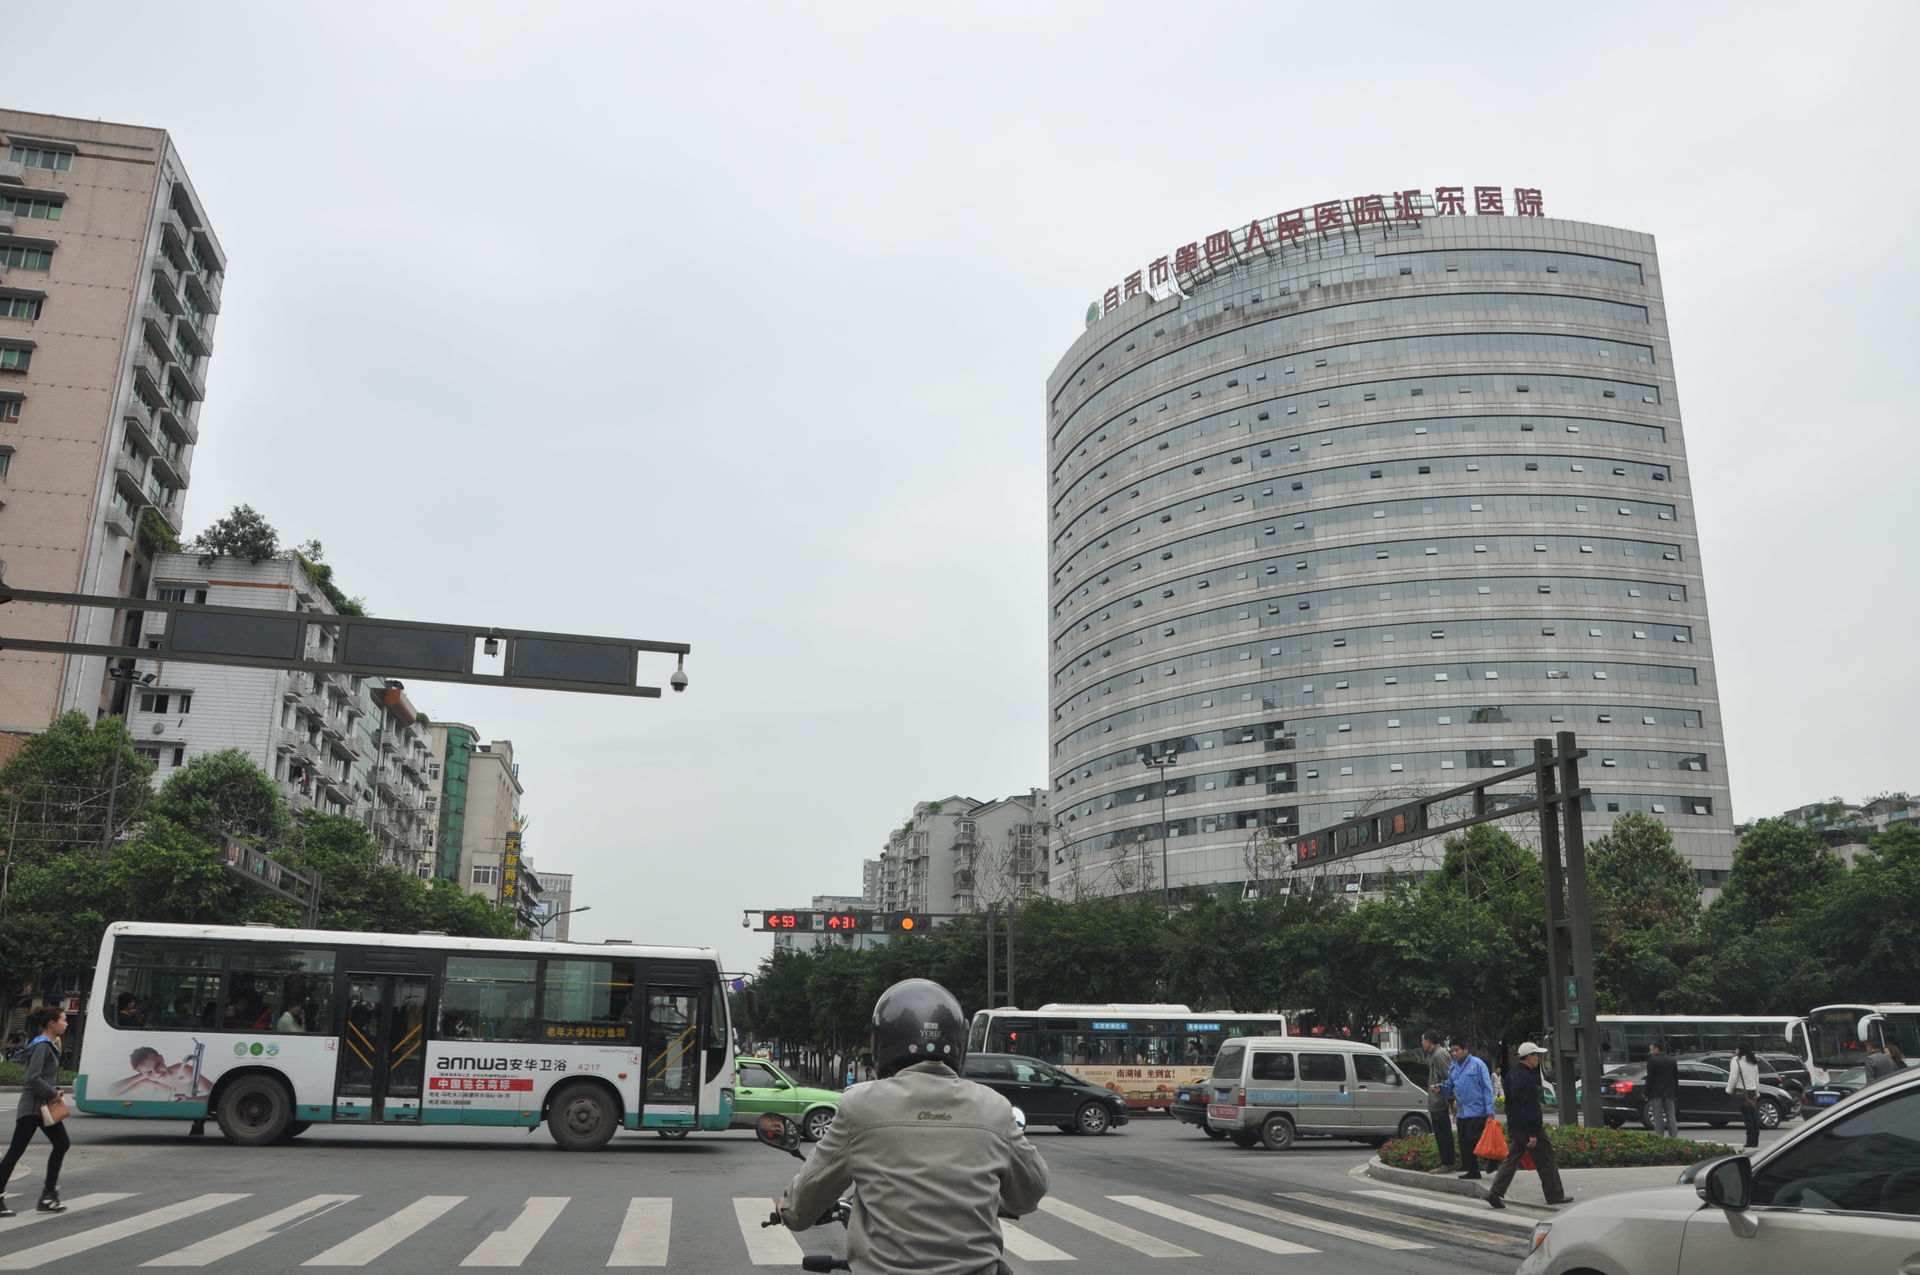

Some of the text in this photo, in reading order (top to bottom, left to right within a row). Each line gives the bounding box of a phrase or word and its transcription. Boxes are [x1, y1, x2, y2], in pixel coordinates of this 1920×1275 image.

[1104, 186, 1545, 315] 自贡市第四人民医院汇东医院
[782, 915, 796, 928] 53
[842, 916, 855, 929] 31
[437, 1057, 567, 1072] annwa 安华卫浴
[438, 1079, 511, 1090] 中国驰名商标
